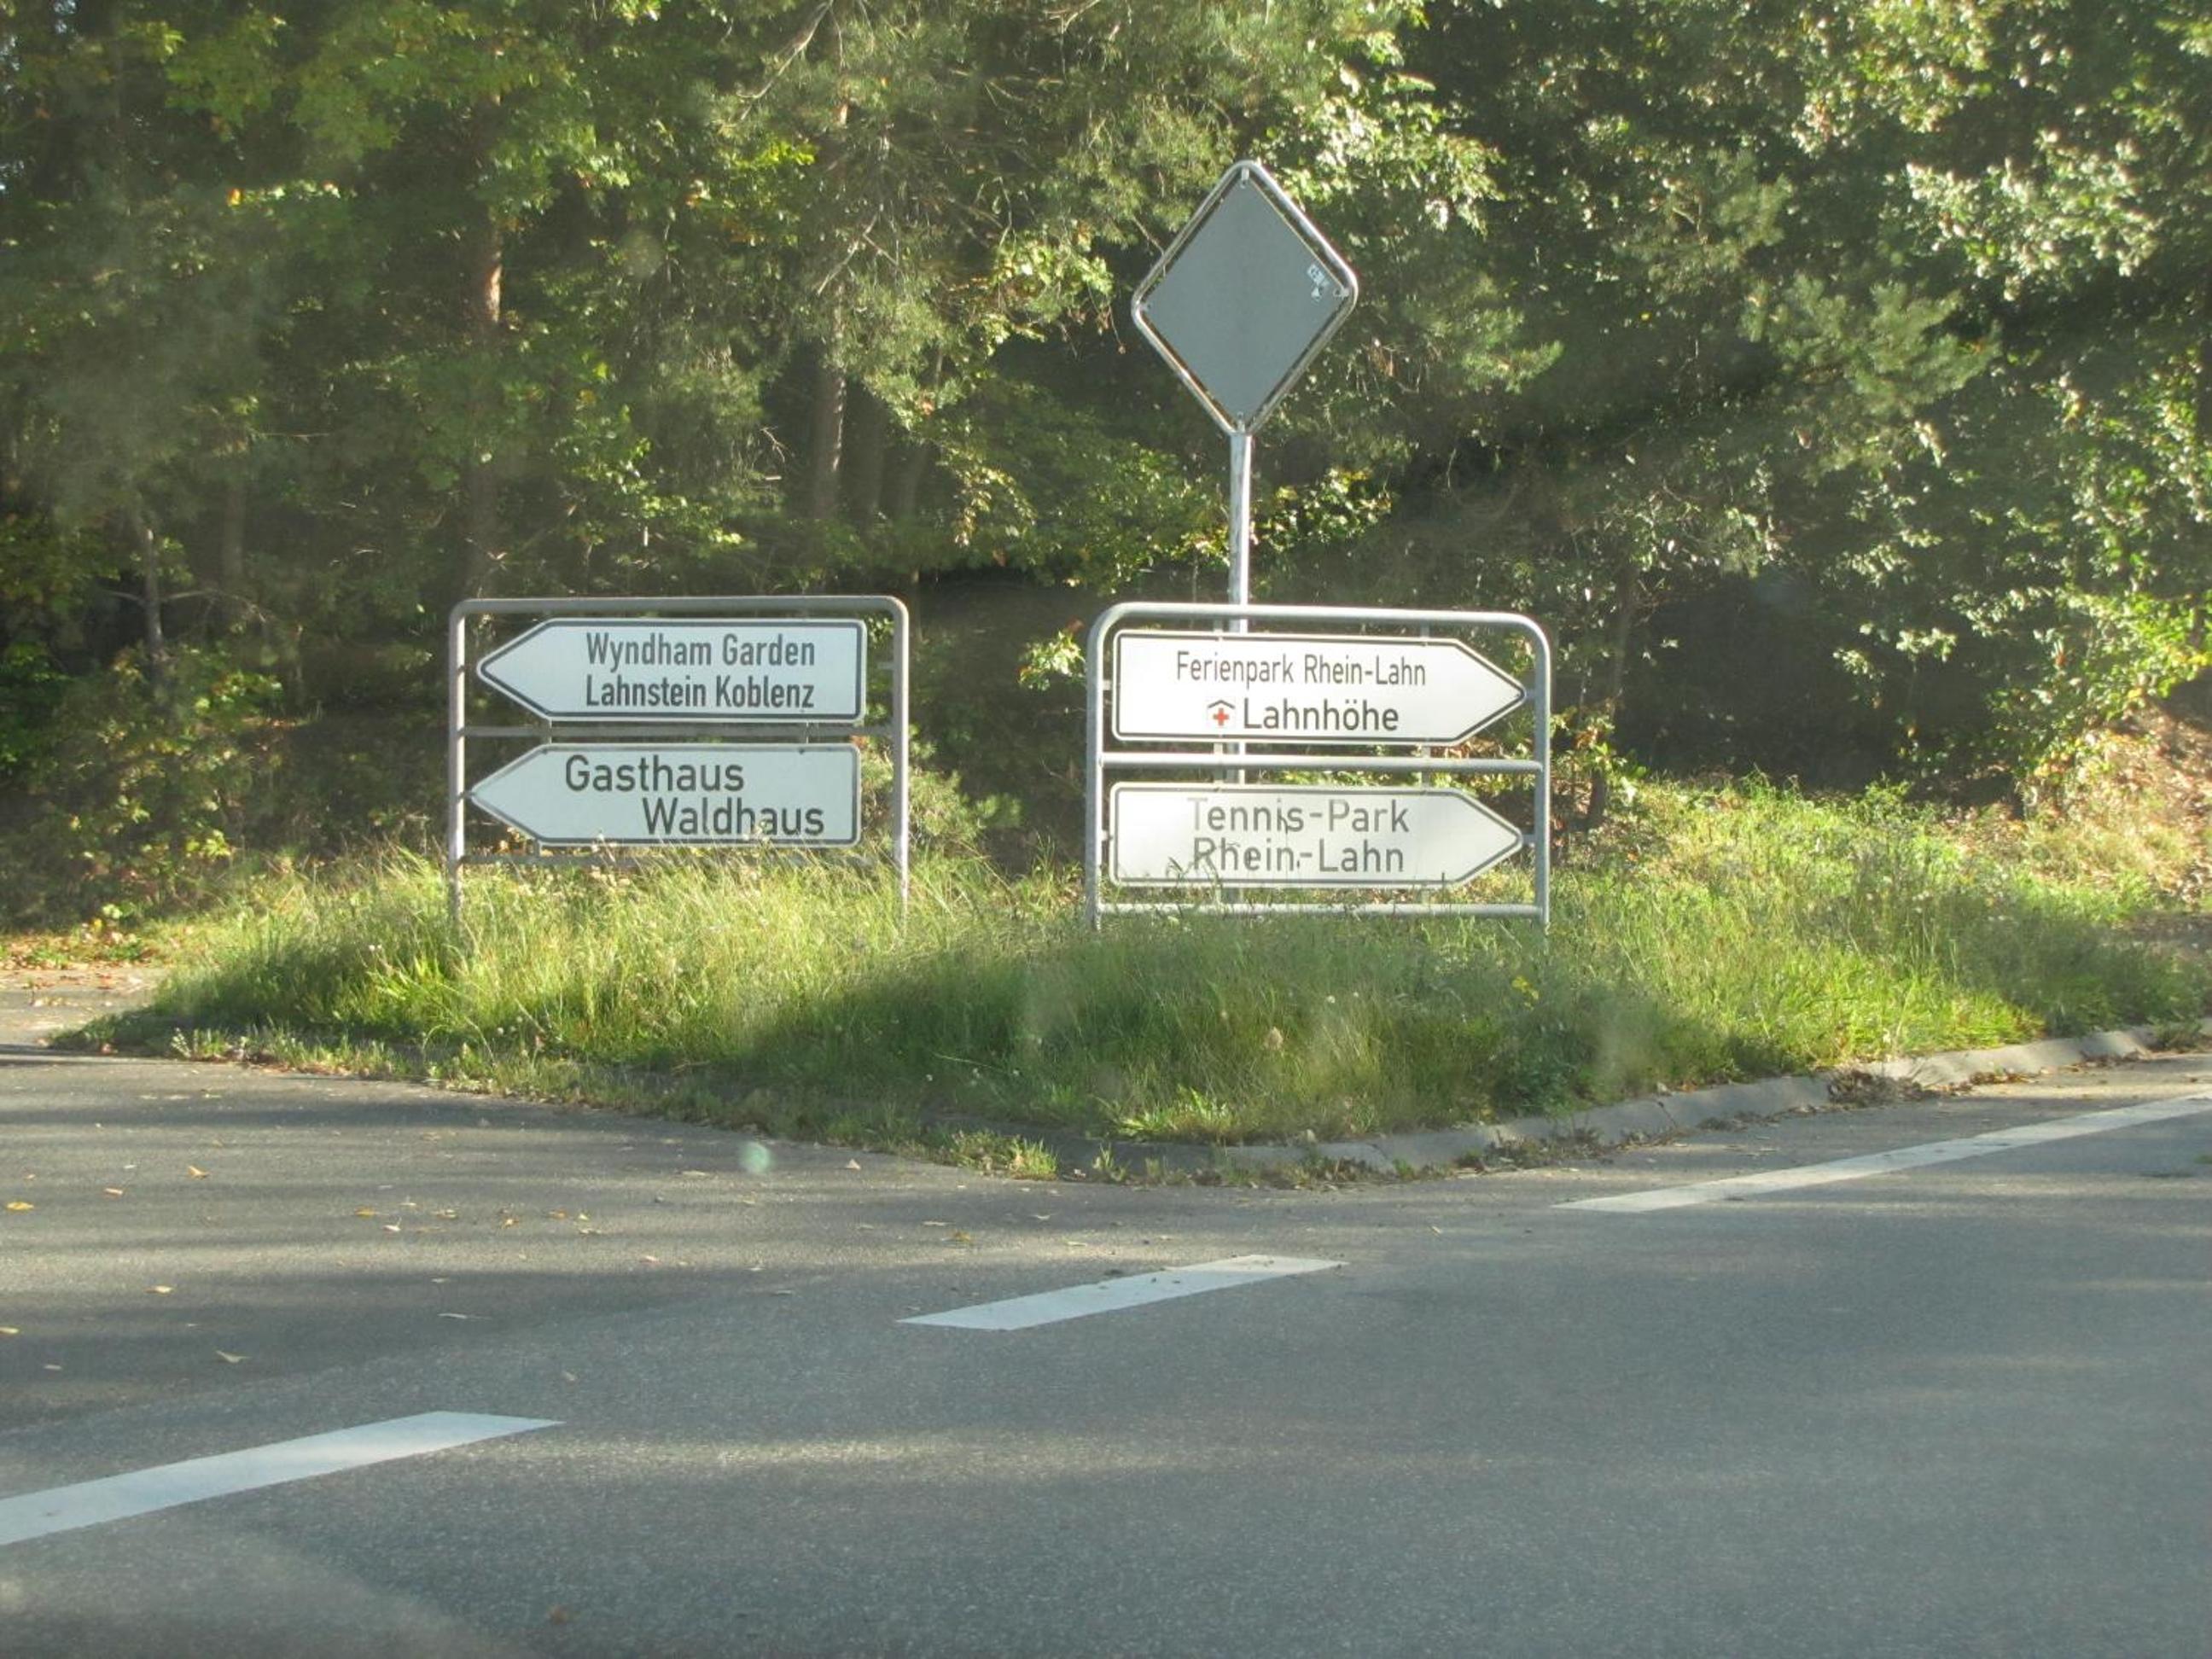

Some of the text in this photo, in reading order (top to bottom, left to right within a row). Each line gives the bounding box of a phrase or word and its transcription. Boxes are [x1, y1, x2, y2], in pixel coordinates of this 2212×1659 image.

[586, 632, 815, 672] Wyndham Garden
[1176, 651, 1426, 689] Ferienpark Rhein-Lahn
[586, 675, 815, 708] Lahnstein Koblenz
[1243, 698, 1399, 731] Lahnhöhe
[565, 754, 745, 792] Gasthaus
[642, 797, 824, 835] Waldhaus
[1187, 797, 1410, 833] Tennis-Park
[1193, 837, 1405, 873] Rhein-Lahn
